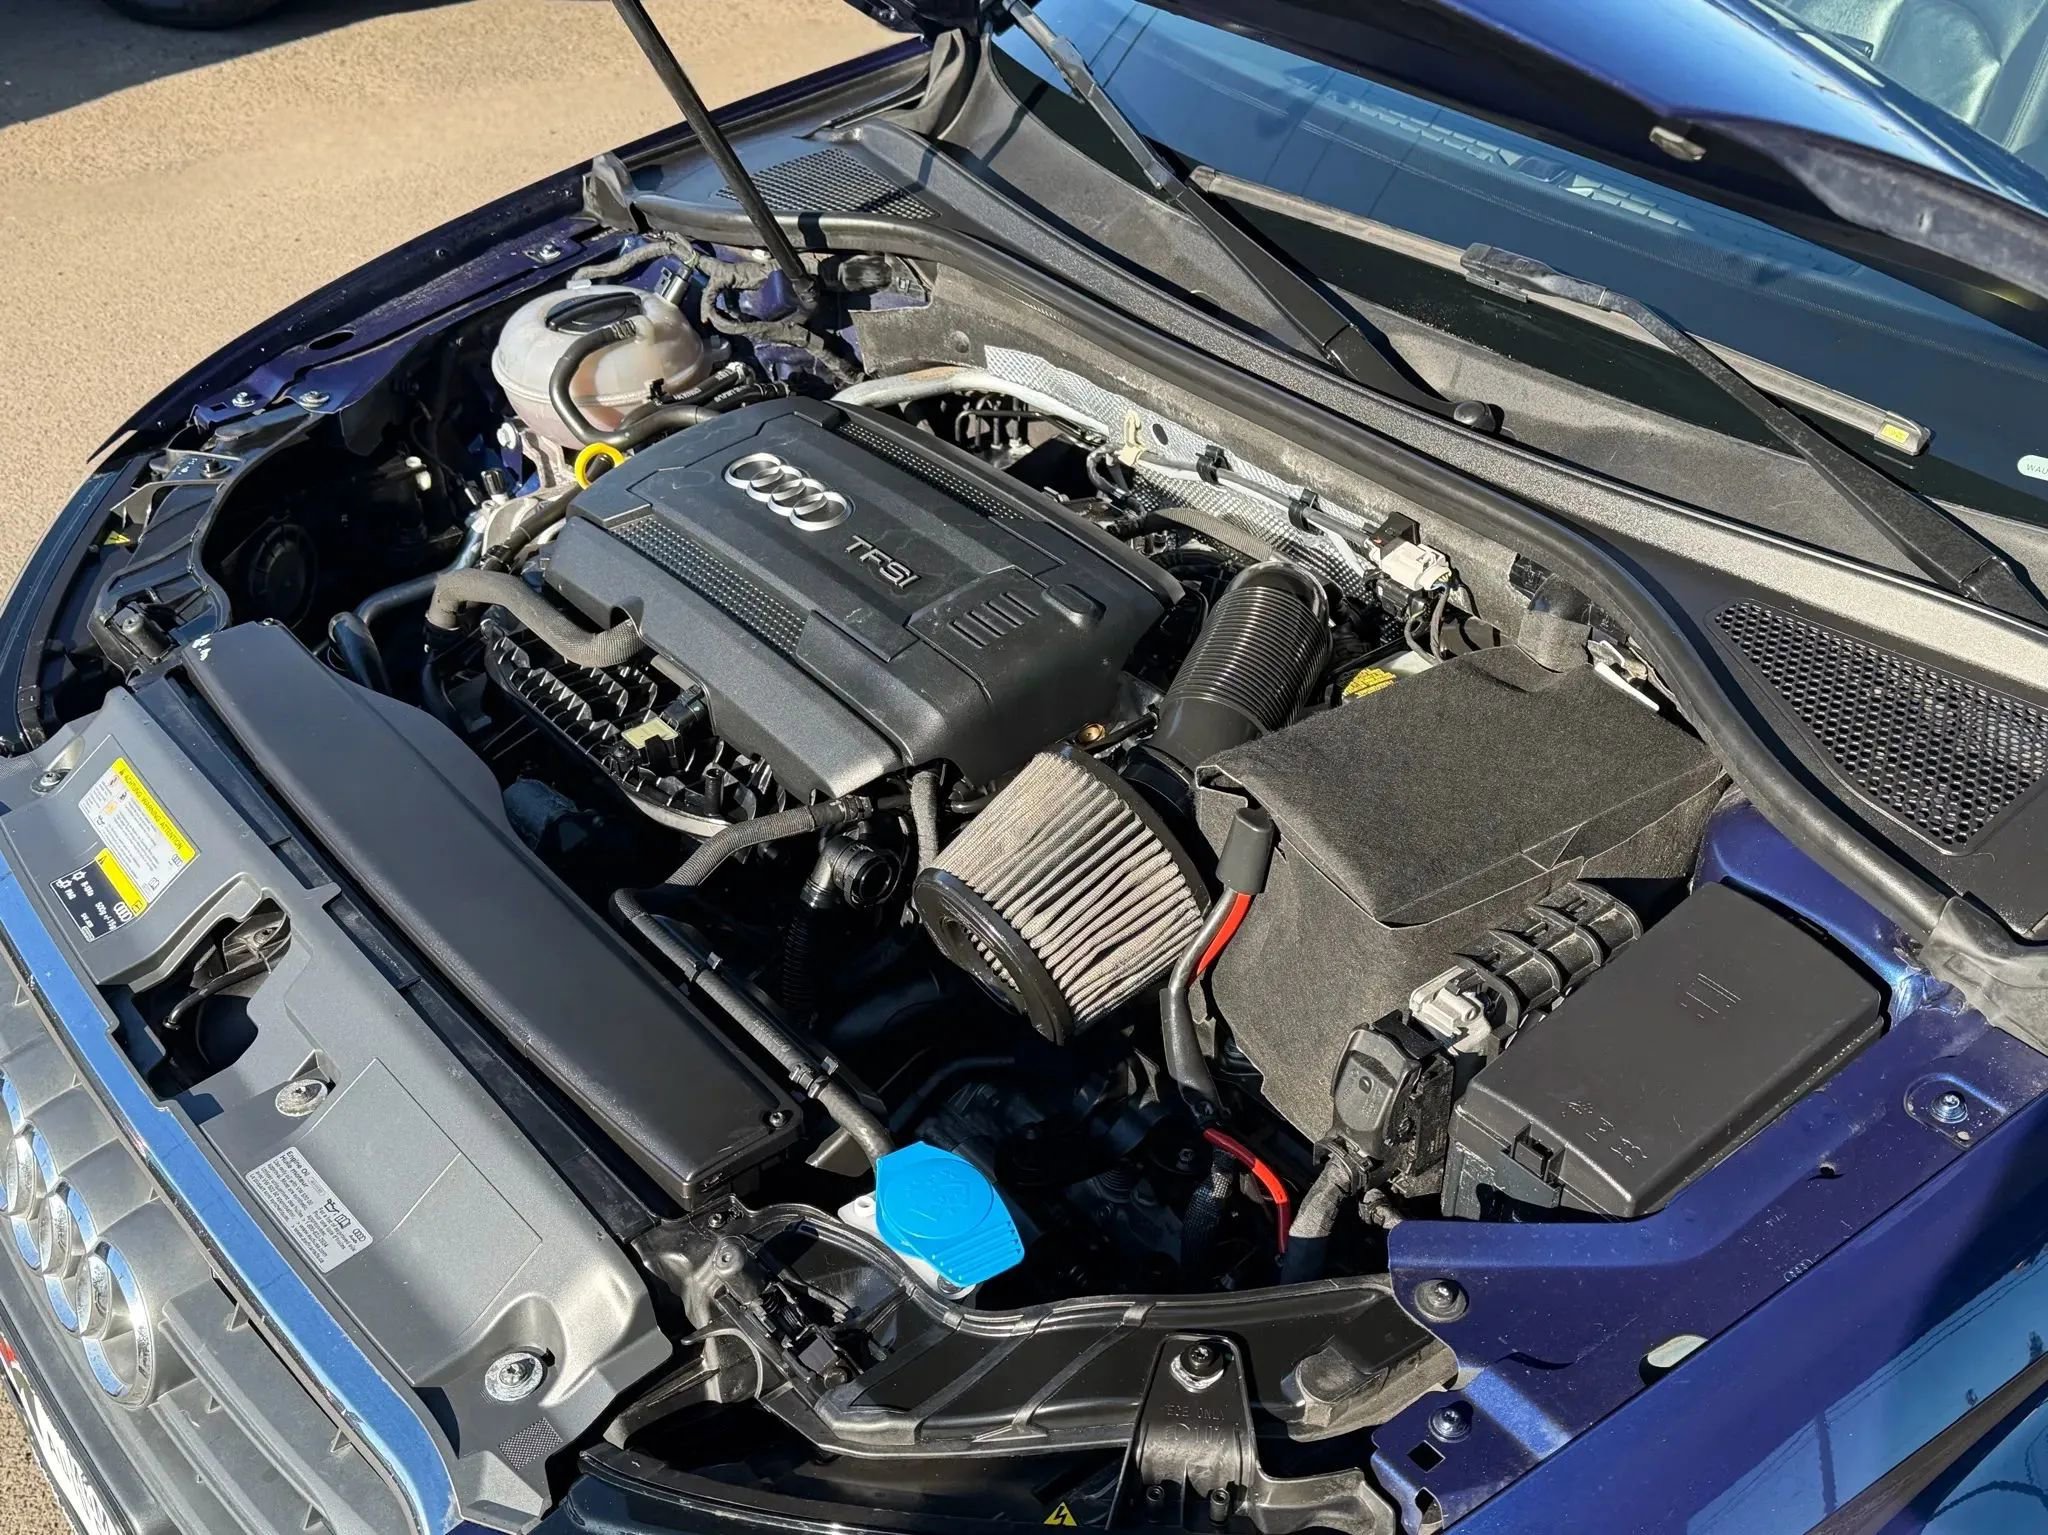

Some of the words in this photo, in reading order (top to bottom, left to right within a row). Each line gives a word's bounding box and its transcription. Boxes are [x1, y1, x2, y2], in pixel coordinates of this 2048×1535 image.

[845, 535, 920, 589] TFSI
[122, 774, 143, 799] ACHTUNG
[139, 796, 162, 823] WARNING
[158, 819, 184, 850] ATTENTION
[285, 1150, 304, 1169] Engine
[299, 1167, 310, 1177] Oil
[290, 1167, 309, 1188] moteur
